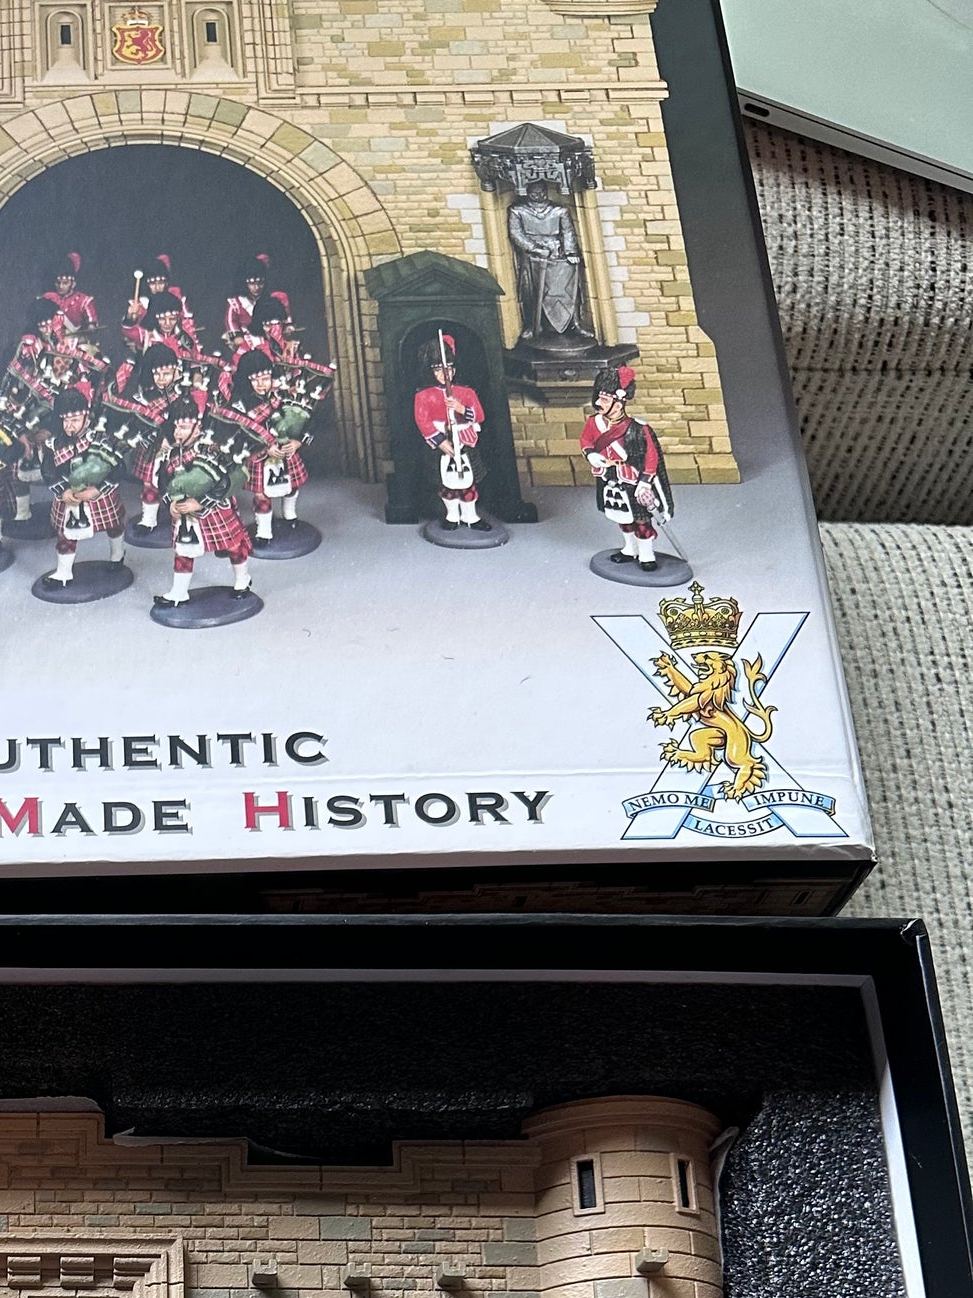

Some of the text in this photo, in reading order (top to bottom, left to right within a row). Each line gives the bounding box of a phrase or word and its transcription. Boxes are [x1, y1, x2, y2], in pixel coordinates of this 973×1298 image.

[628, 793, 710, 810] NEMO ME
[755, 792, 825, 807] IMPUNE
[243, 791, 553, 832] HISTORY
[694, 818, 774, 837] LACESSIT
